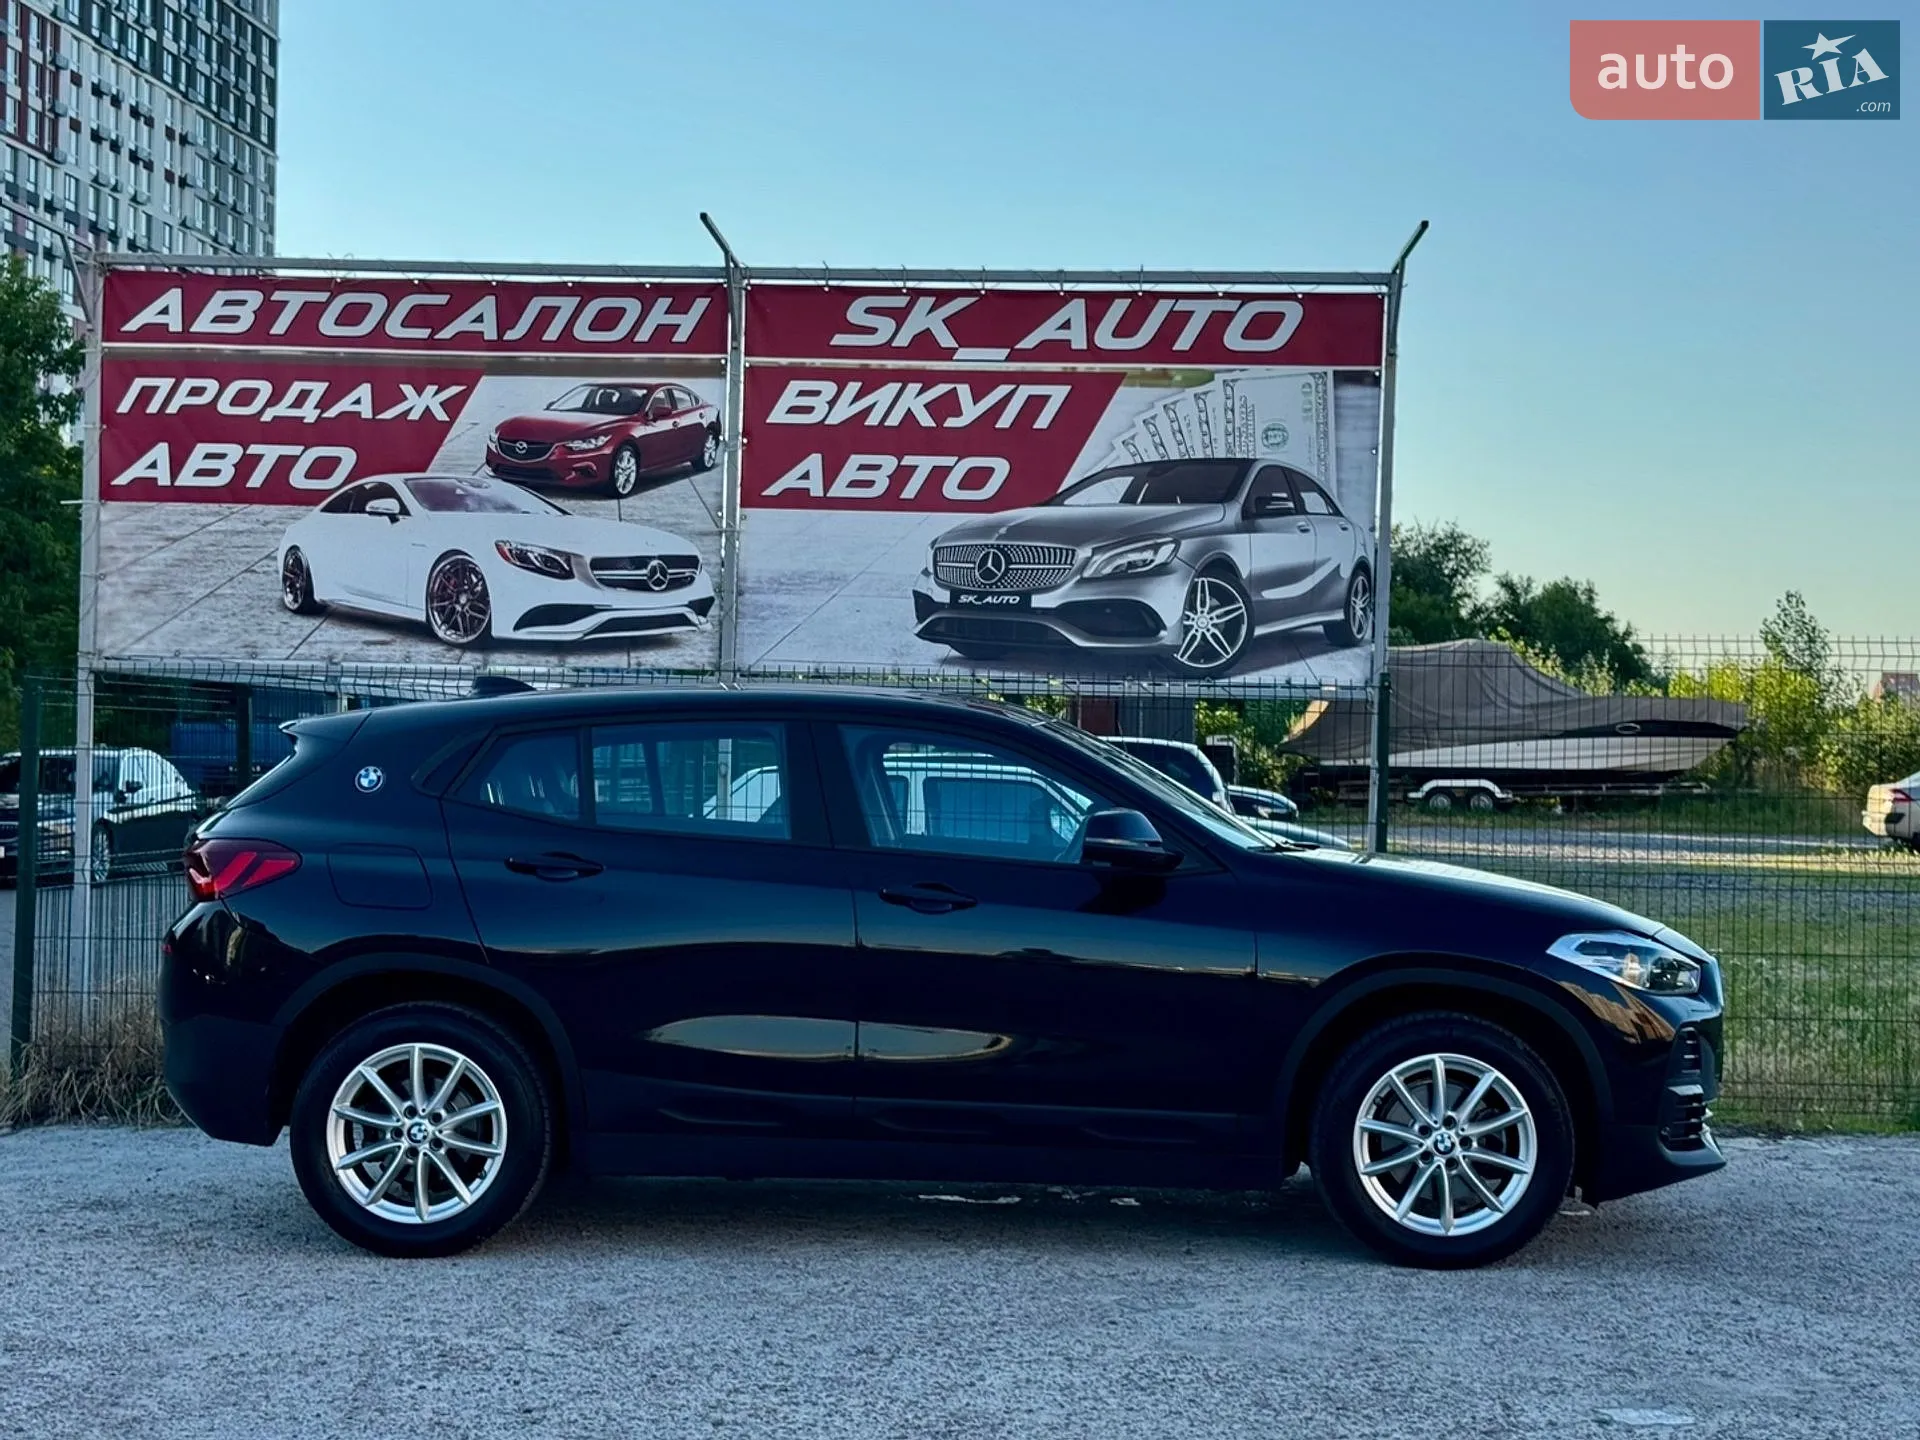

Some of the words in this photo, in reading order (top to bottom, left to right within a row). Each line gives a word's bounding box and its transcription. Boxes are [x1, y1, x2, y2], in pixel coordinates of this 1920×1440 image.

[121, 287, 712, 344] АВТОСАЛОН
[829, 294, 1304, 361] SK_AUTO
[116, 376, 467, 424] ПРОДАЖ
[765, 379, 1072, 429] ВИКУП
[110, 442, 358, 491] АВТО
[761, 453, 1011, 501] АВТО
[957, 594, 1021, 606] SK_AUTO
